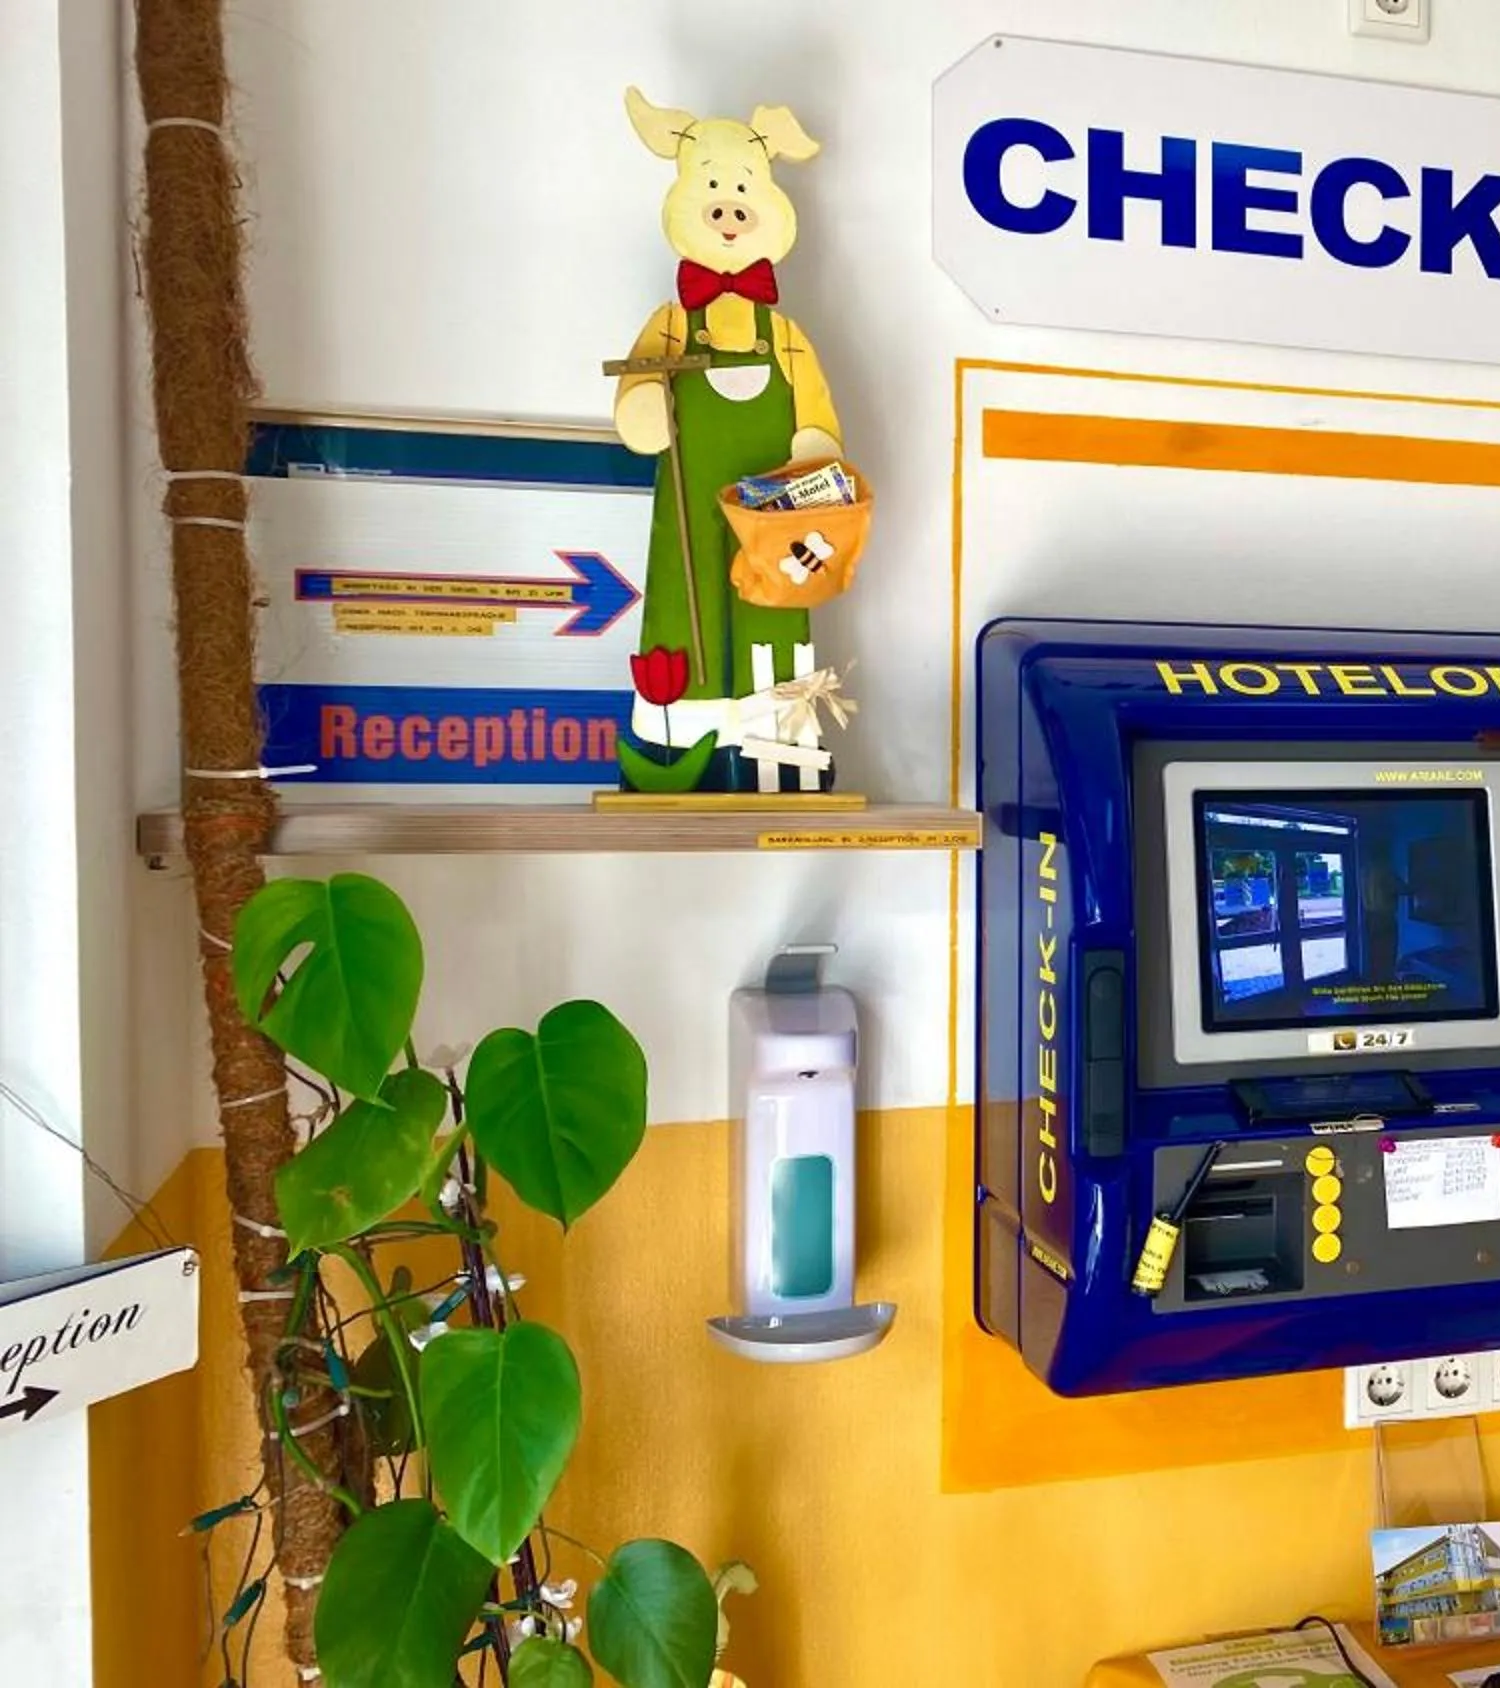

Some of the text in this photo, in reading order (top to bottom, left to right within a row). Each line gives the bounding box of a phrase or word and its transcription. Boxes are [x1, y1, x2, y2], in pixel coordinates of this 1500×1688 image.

[320, 704, 618, 767] Reception
[1039, 831, 1057, 1203] CHECK-IN
[1363, 1032, 1407, 1047] 24/7
